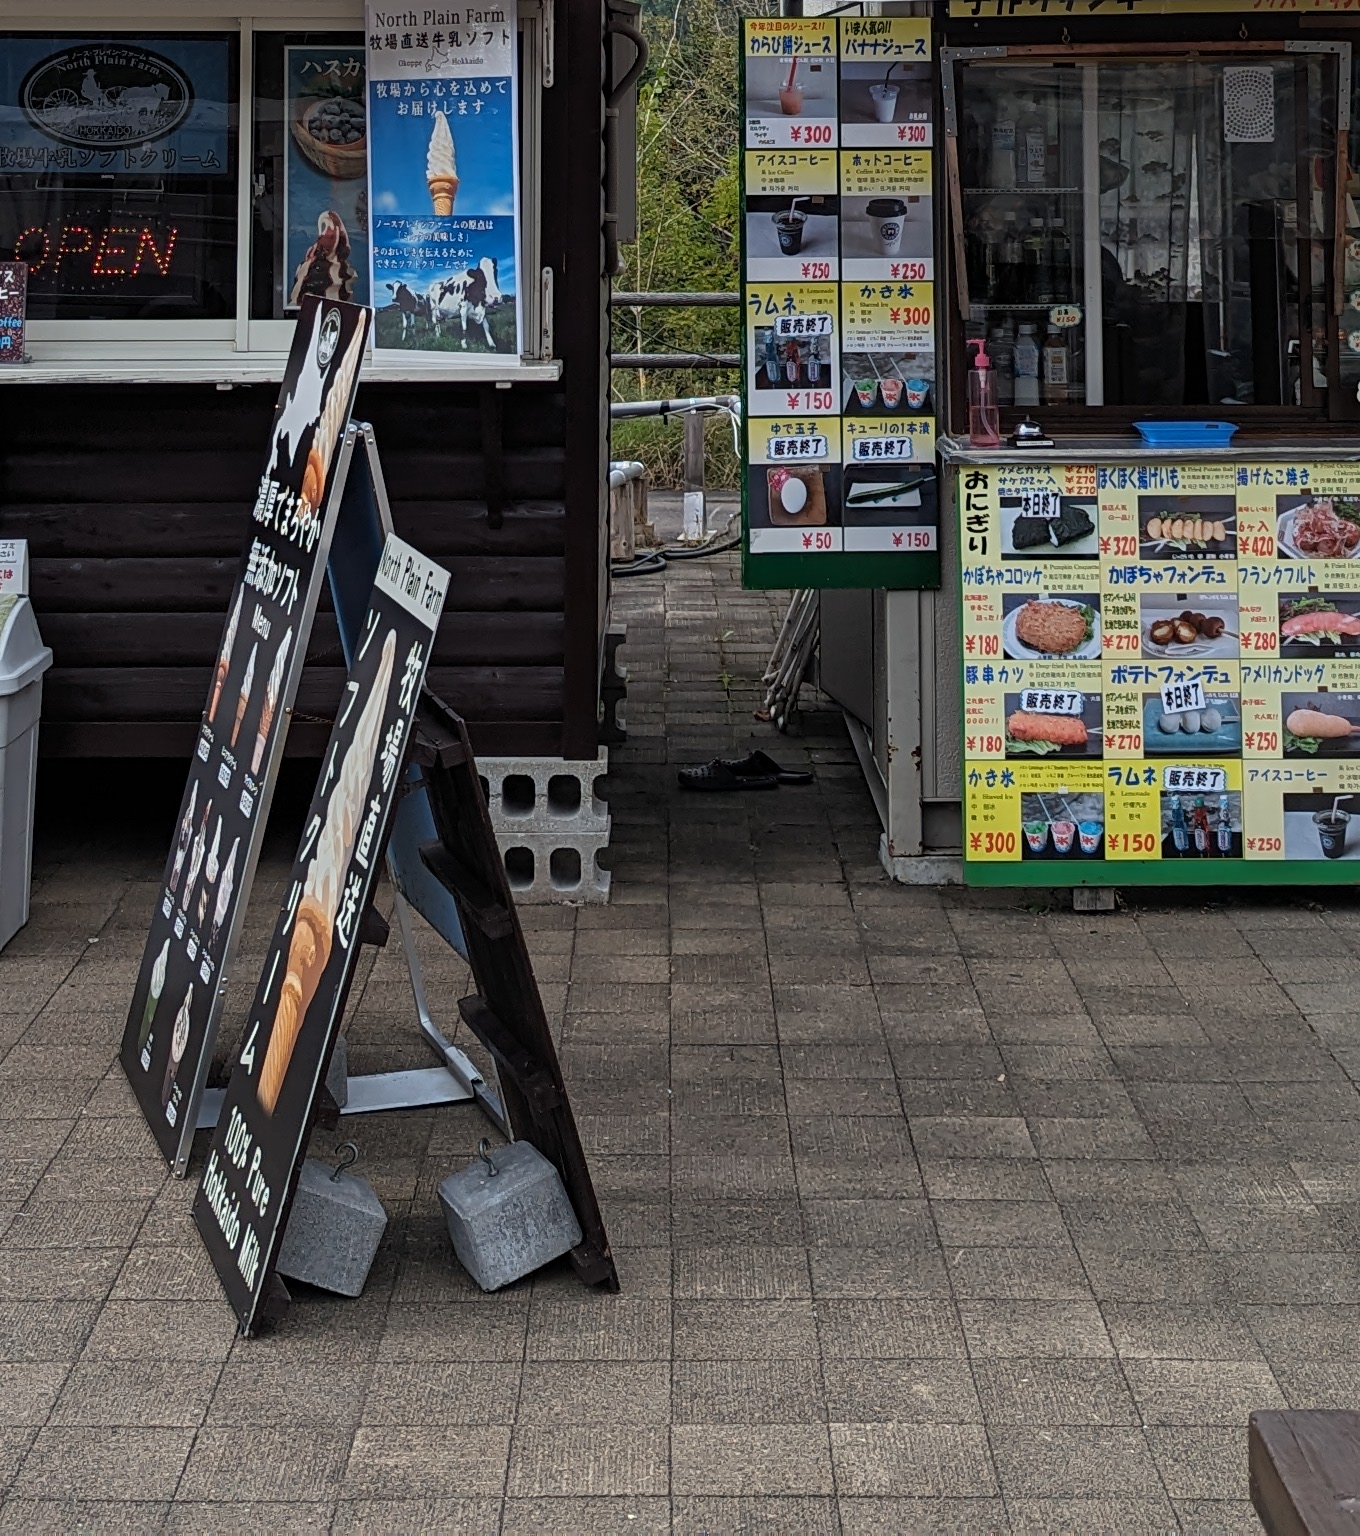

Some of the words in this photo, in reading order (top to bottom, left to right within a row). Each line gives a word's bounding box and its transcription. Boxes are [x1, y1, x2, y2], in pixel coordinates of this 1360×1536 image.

[375, 11, 418, 28] North
[423, 9, 463, 26] Plain
[466, 7, 505, 24] Farm
[369, 29, 511, 51] 牧場直送牛乳ソフト
[750, 35, 832, 55] わらび餅ジュース
[56, 55, 92, 74] North
[94, 53, 128, 67] Plain
[130, 57, 160, 76] Farm
[376, 79, 508, 98] 牧場から心を込めて
[397, 100, 485, 116] お届けします
[79, 125, 132, 136] HOKKAIDO
[790, 125, 832, 144] ¥300
[755, 154, 830, 167] アイスコーヒー
[852, 154, 923, 167] ホットコーヒー
[15, 225, 180, 277] OPEN
[860, 284, 915, 300] かき氷
[748, 292, 798, 316] ラムネ
[889, 306, 931, 327] ¥300
[787, 392, 833, 411] ¥150
[770, 422, 819, 435] ゆで玉子
[1097, 467, 1181, 490] ほくほく揚げいも
[1236, 466, 1310, 487] 揚げたこ焼き
[964, 470, 990, 556] おにぎり
[801, 532, 832, 550] ¥50
[892, 531, 930, 549] ¥150
[1099, 535, 1137, 557] ¥320
[1238, 536, 1274, 556] ¥420
[379, 541, 403, 585] North
[400, 556, 421, 600] Plain
[420, 570, 443, 616] Farm
[963, 567, 1043, 586] かぼちゃコロッケ
[1108, 565, 1227, 585] かぼちゃフォンデュ
[1238, 565, 1316, 585] フランクフルト
[965, 634, 999, 655] ¥180
[1240, 631, 1277, 652] ¥280
[965, 665, 1024, 684] 豚串カツ
[1110, 665, 1231, 685] ポテトフォンデュ
[1241, 664, 1326, 684] アメリカンドッグ
[1164, 683, 1200, 710] 本日終了
[966, 736, 1003, 753] ¥180
[1244, 732, 1278, 752] ¥250
[967, 767, 1016, 787] かき氷
[1107, 767, 1158, 786] ラムネ
[1248, 767, 1328, 782] アイスコーヒー
[335, 640, 424, 948] 牧場直送
[240, 609, 381, 1075] ソフトクリーム
[969, 832, 1016, 854] ¥300
[1107, 833, 1156, 853] ¥150
[224, 1105, 253, 1170] 100%
[246, 1146, 271, 1217] Pure
[202, 1149, 241, 1250] Hokkaido
[237, 1223, 261, 1292] Milk
